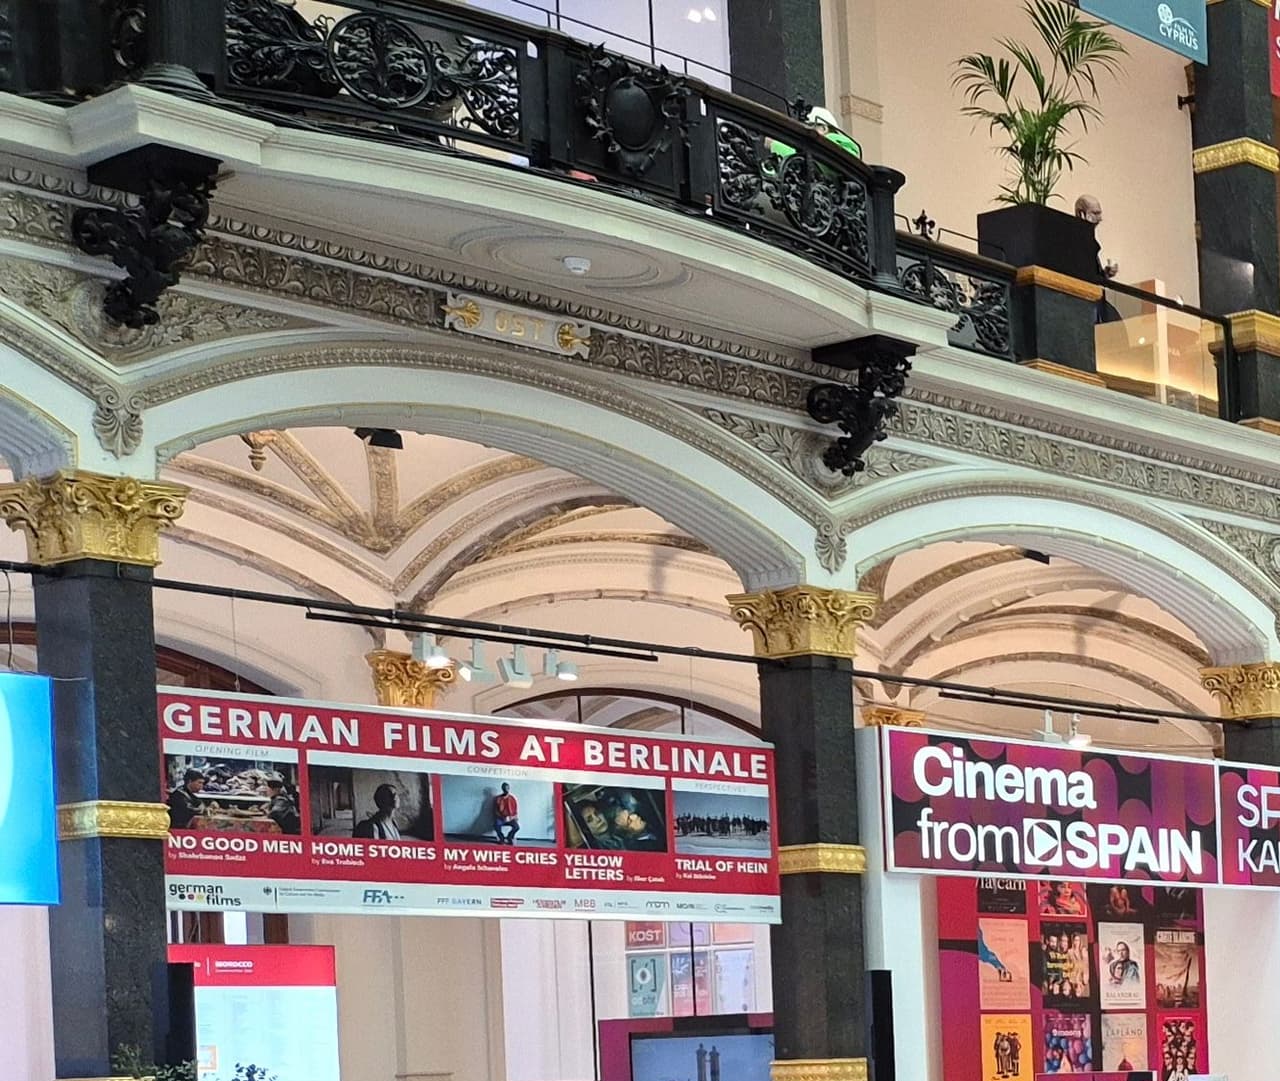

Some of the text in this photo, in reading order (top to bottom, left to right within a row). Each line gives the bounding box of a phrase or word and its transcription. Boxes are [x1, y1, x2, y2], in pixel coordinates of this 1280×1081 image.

[1159, 24, 1199, 50] CYPRUS
[163, 702, 767, 779] GERMAN FILMS AT BERLINALE
[195, 744, 269, 759] OPENING FILM
[467, 766, 528, 777] COMPETITION
[913, 746, 1097, 809] Cinema
[168, 835, 302, 855] NO GOOD MEN
[917, 808, 1203, 875] from SPAIN
[311, 842, 436, 860] HOME STORIES
[444, 848, 557, 865] MY WIFE CRIES
[565, 854, 623, 868] YELLOW
[675, 859, 768, 874] TRIAL OF HEIN
[565, 867, 623, 881] LETTERS
[169, 883, 223, 896] german
[206, 893, 241, 906] films
